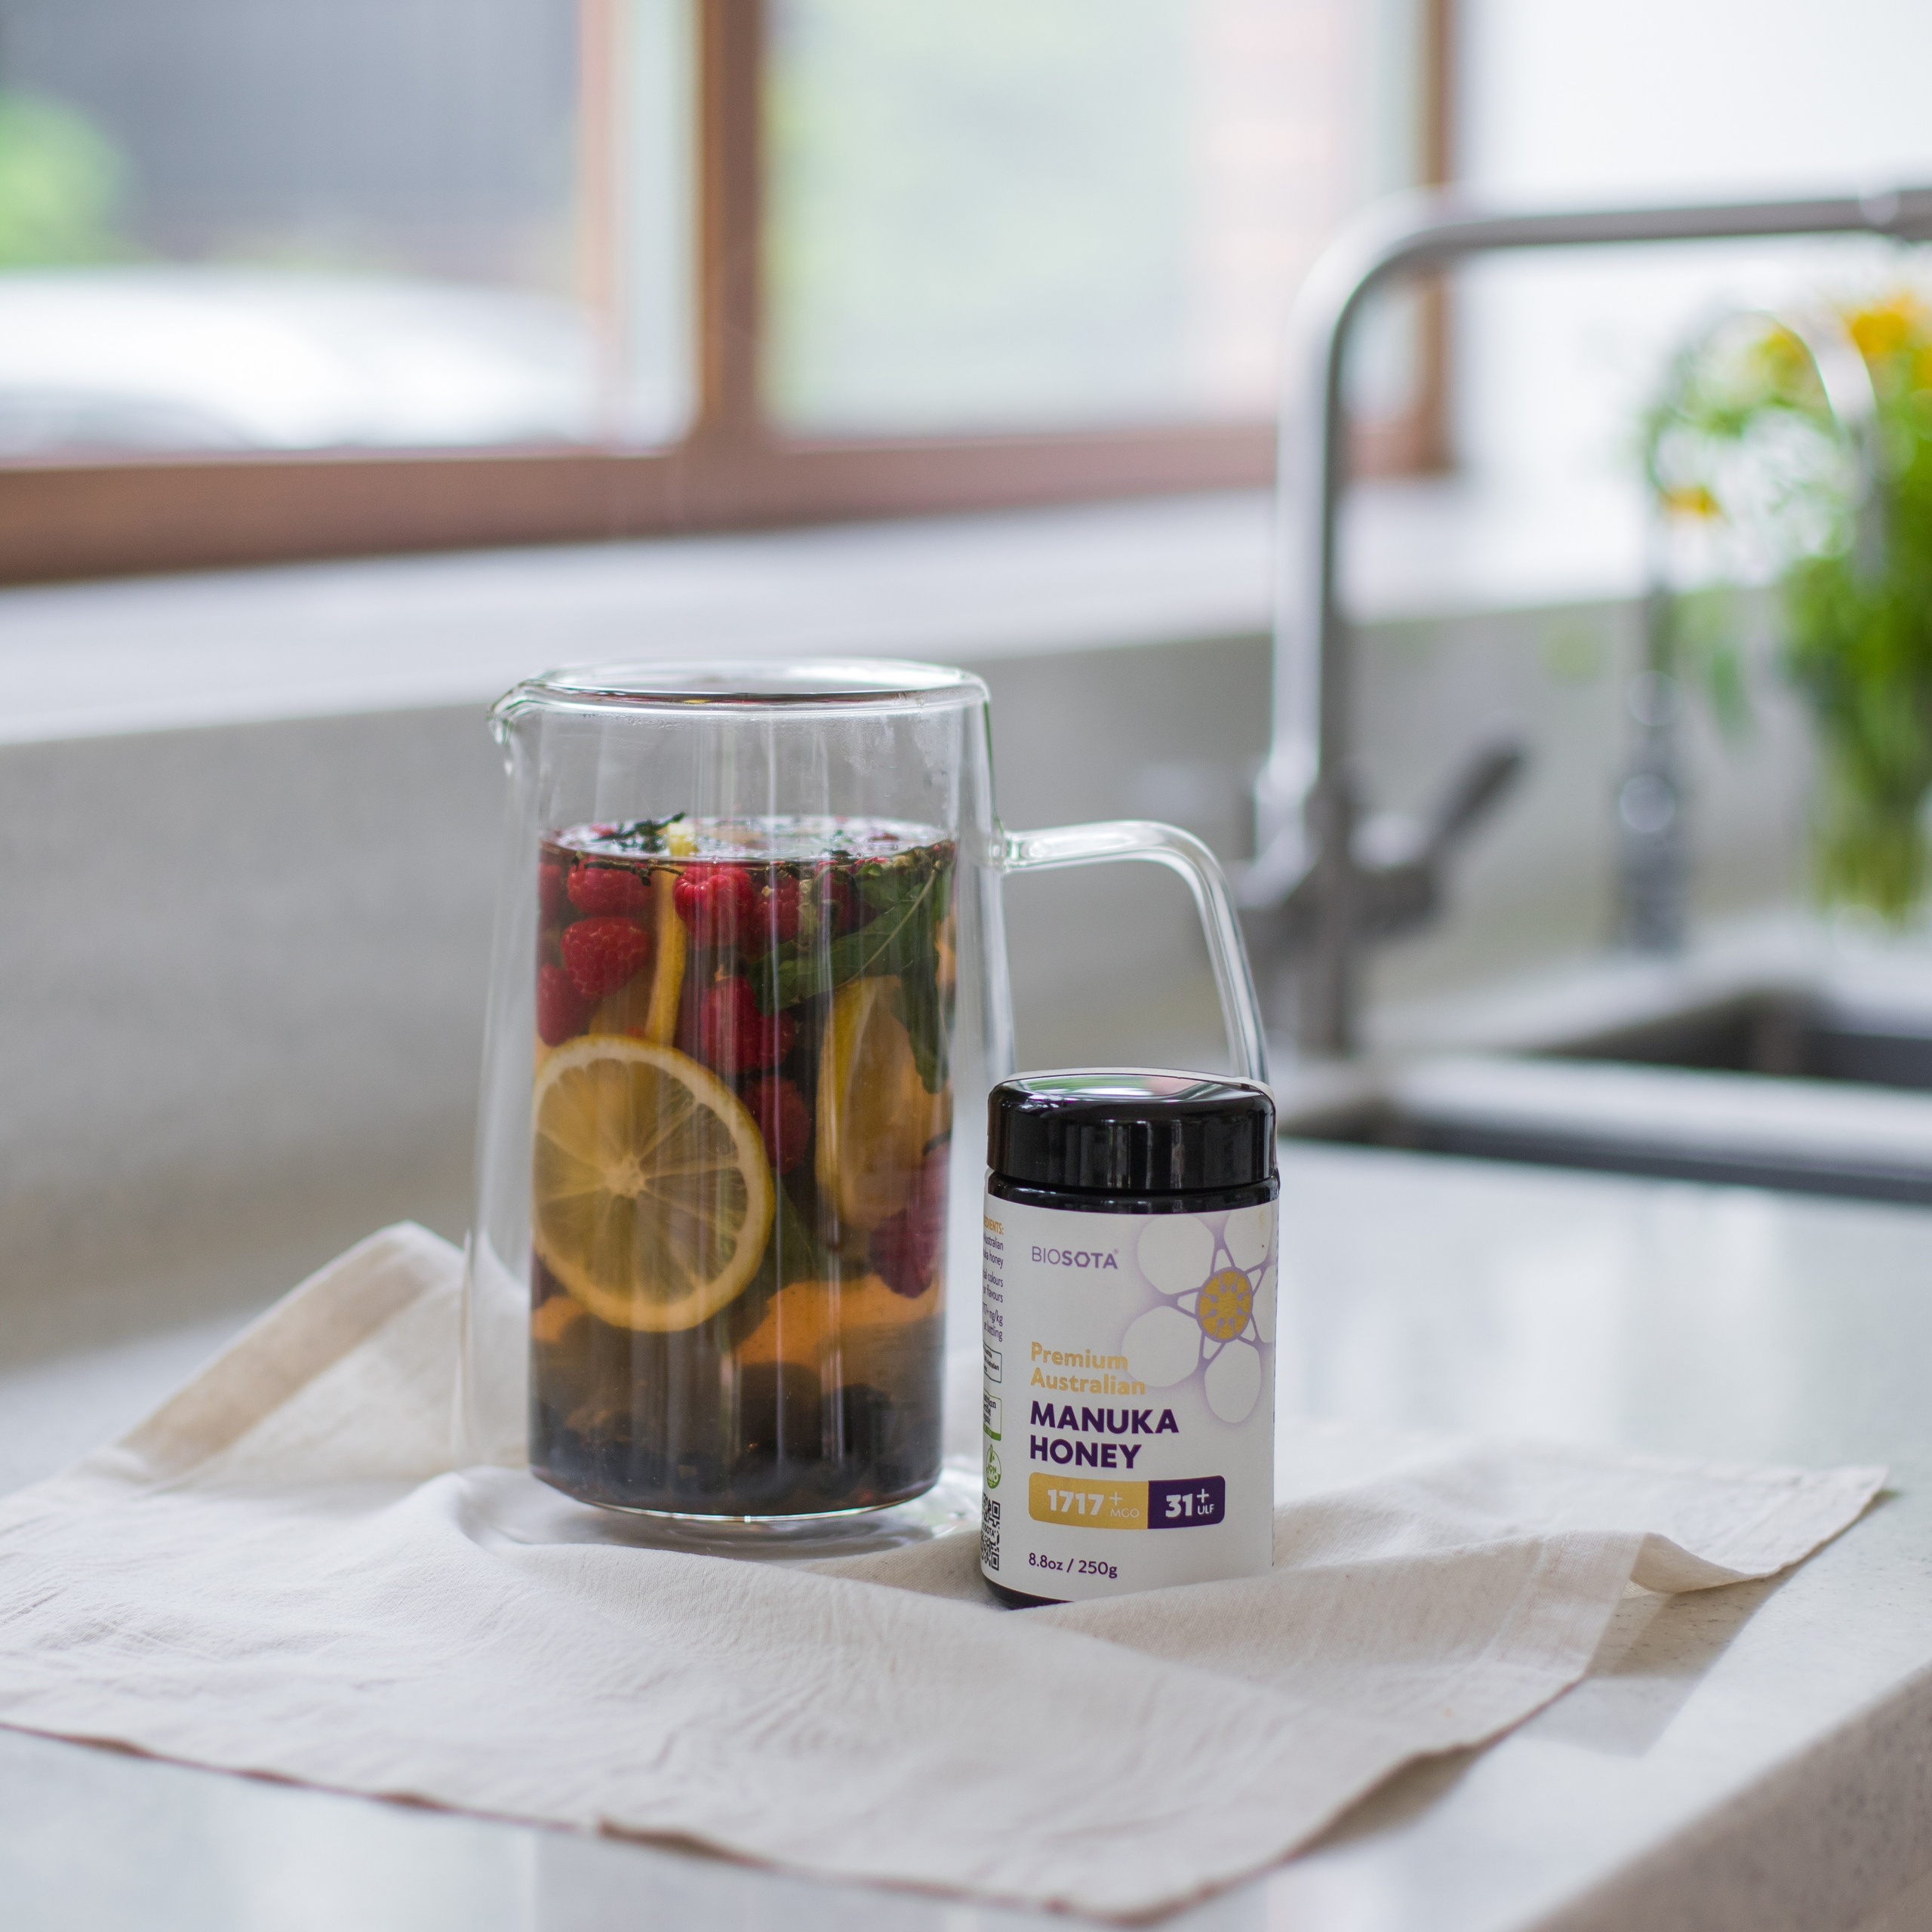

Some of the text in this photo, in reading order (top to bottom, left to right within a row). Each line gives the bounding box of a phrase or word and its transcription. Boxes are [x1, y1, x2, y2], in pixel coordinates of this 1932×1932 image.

[989, 1249, 1004, 1269] honey
[1032, 1245, 1118, 1269] BIOSOTA
[987, 1271, 1004, 1287] colours
[986, 1284, 1004, 1303] flavours
[986, 1321, 1003, 1342] bottling
[1030, 1341, 1128, 1371] Premium
[1030, 1367, 1146, 1395] Australian
[1030, 1400, 1180, 1435] MANUKA
[1030, 1434, 1143, 1469] HONEY
[1110, 1509, 1140, 1518] MGO
[1197, 1503, 1215, 1515] ULF
[1029, 1552, 1118, 1579] 8.8oz / 250g
